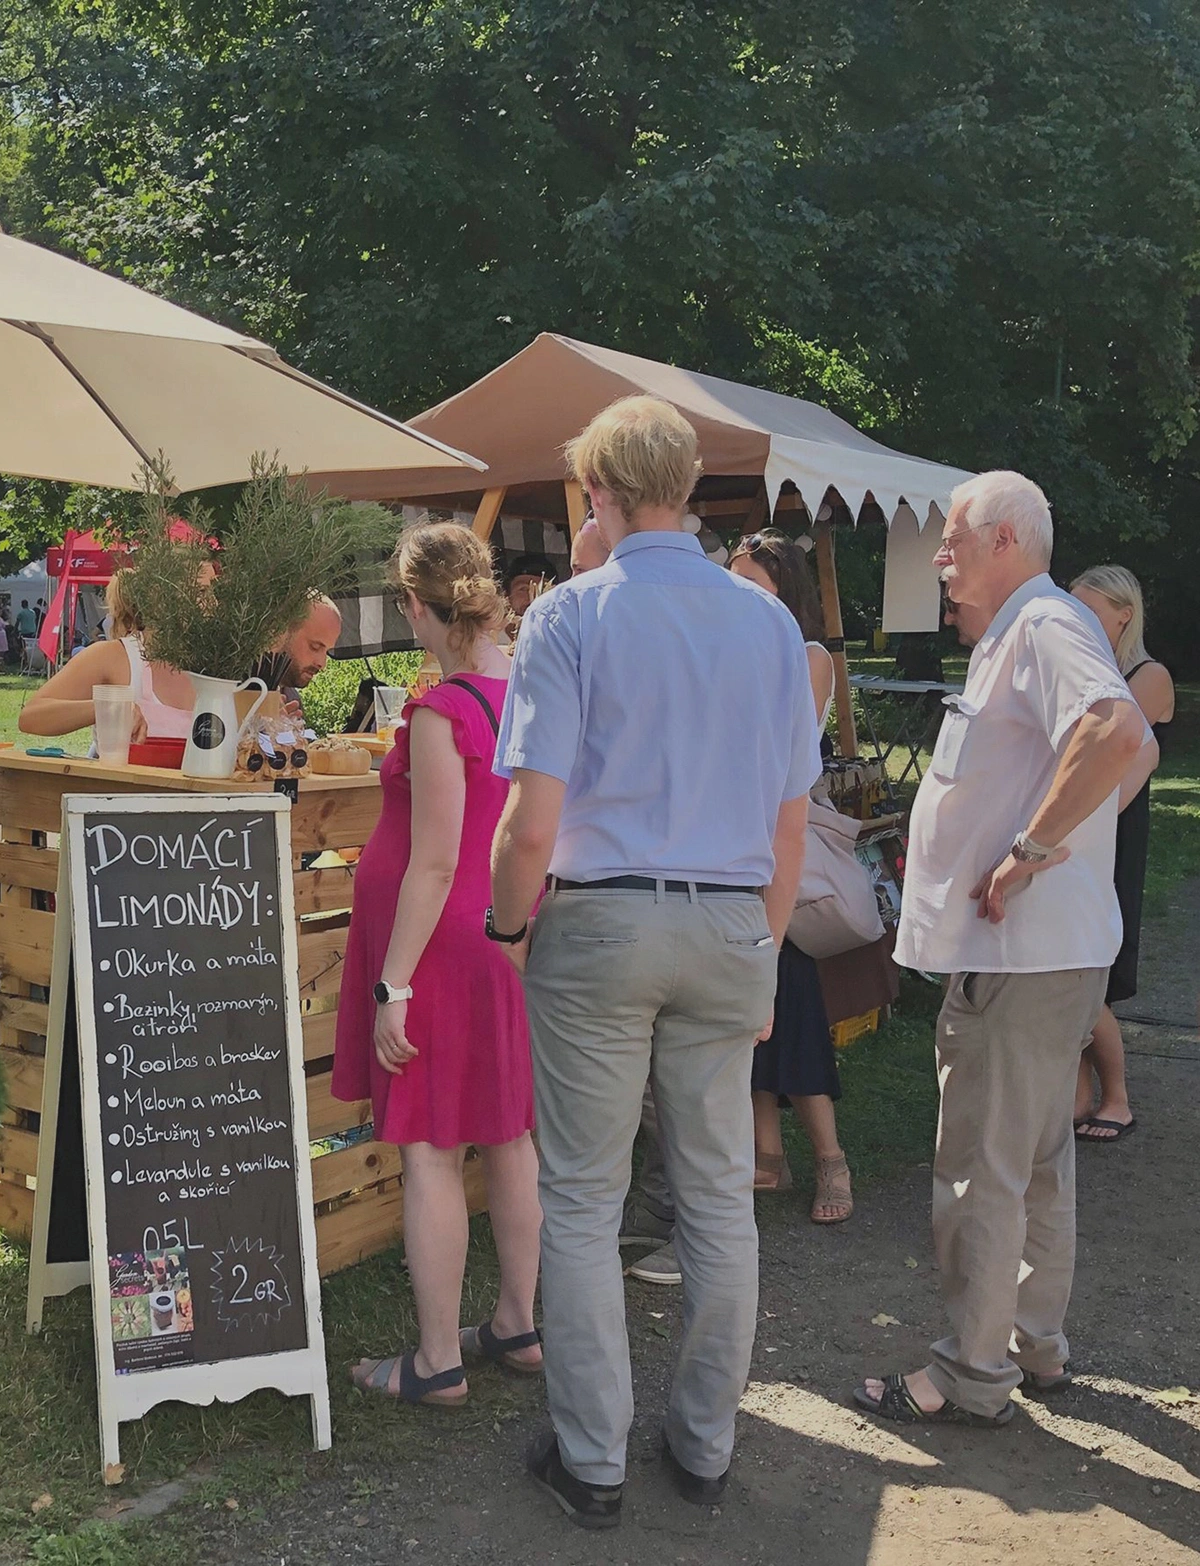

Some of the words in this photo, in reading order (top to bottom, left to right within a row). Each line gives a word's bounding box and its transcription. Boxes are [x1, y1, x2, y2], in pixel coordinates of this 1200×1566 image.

[86, 818, 263, 875] DOMÁCÍ
[94, 875, 274, 930] LIMONÁDY:
[206, 957, 221, 969] a
[118, 1043, 198, 1079] Rooibos
[205, 1056, 216, 1066] a
[124, 1087, 186, 1117] Meloun
[191, 1096, 204, 1109] a
[211, 1079, 261, 1106] máta
[123, 1122, 200, 1148] Ostružiny
[206, 1126, 215, 1137] s
[125, 1158, 212, 1185] Levandule
[220, 1164, 231, 1177] s
[159, 1191, 170, 1202] a
